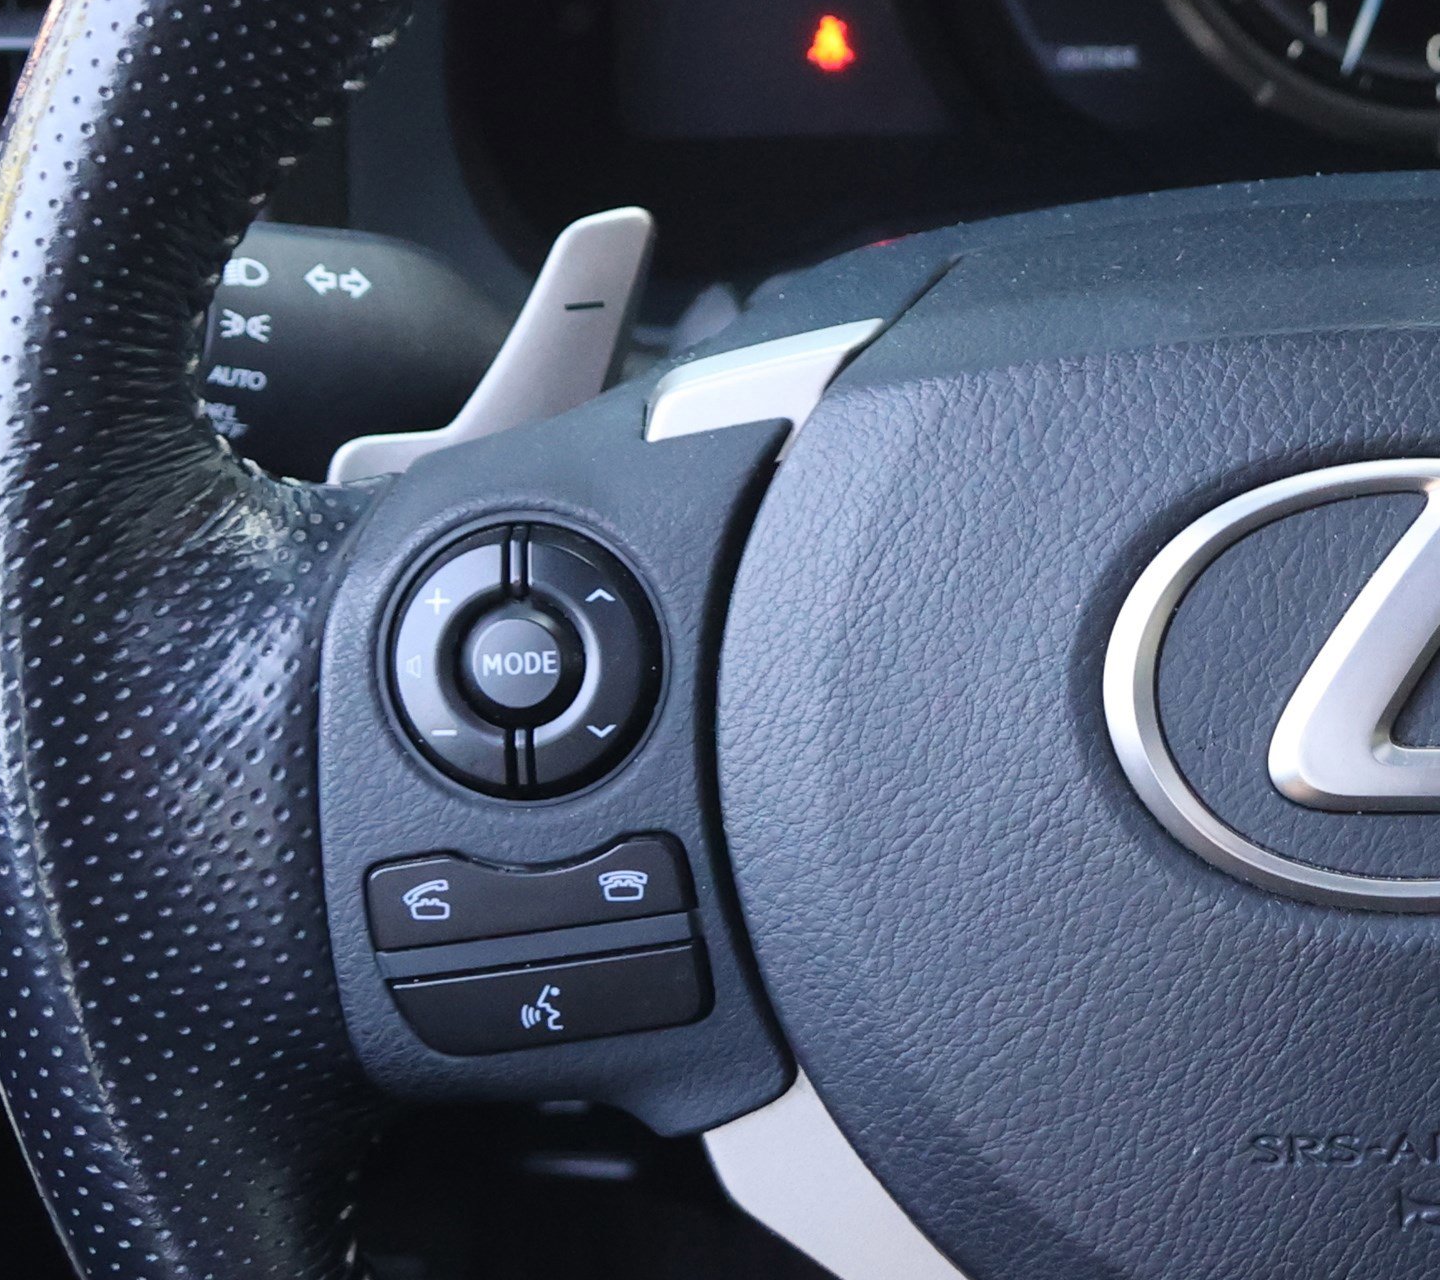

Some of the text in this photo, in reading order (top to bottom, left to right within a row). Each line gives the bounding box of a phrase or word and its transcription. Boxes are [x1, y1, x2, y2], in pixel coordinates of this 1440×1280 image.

[1310, 0, 1328, 38] 1
[206, 364, 268, 391] AUTO
[482, 650, 559, 676] MODE
